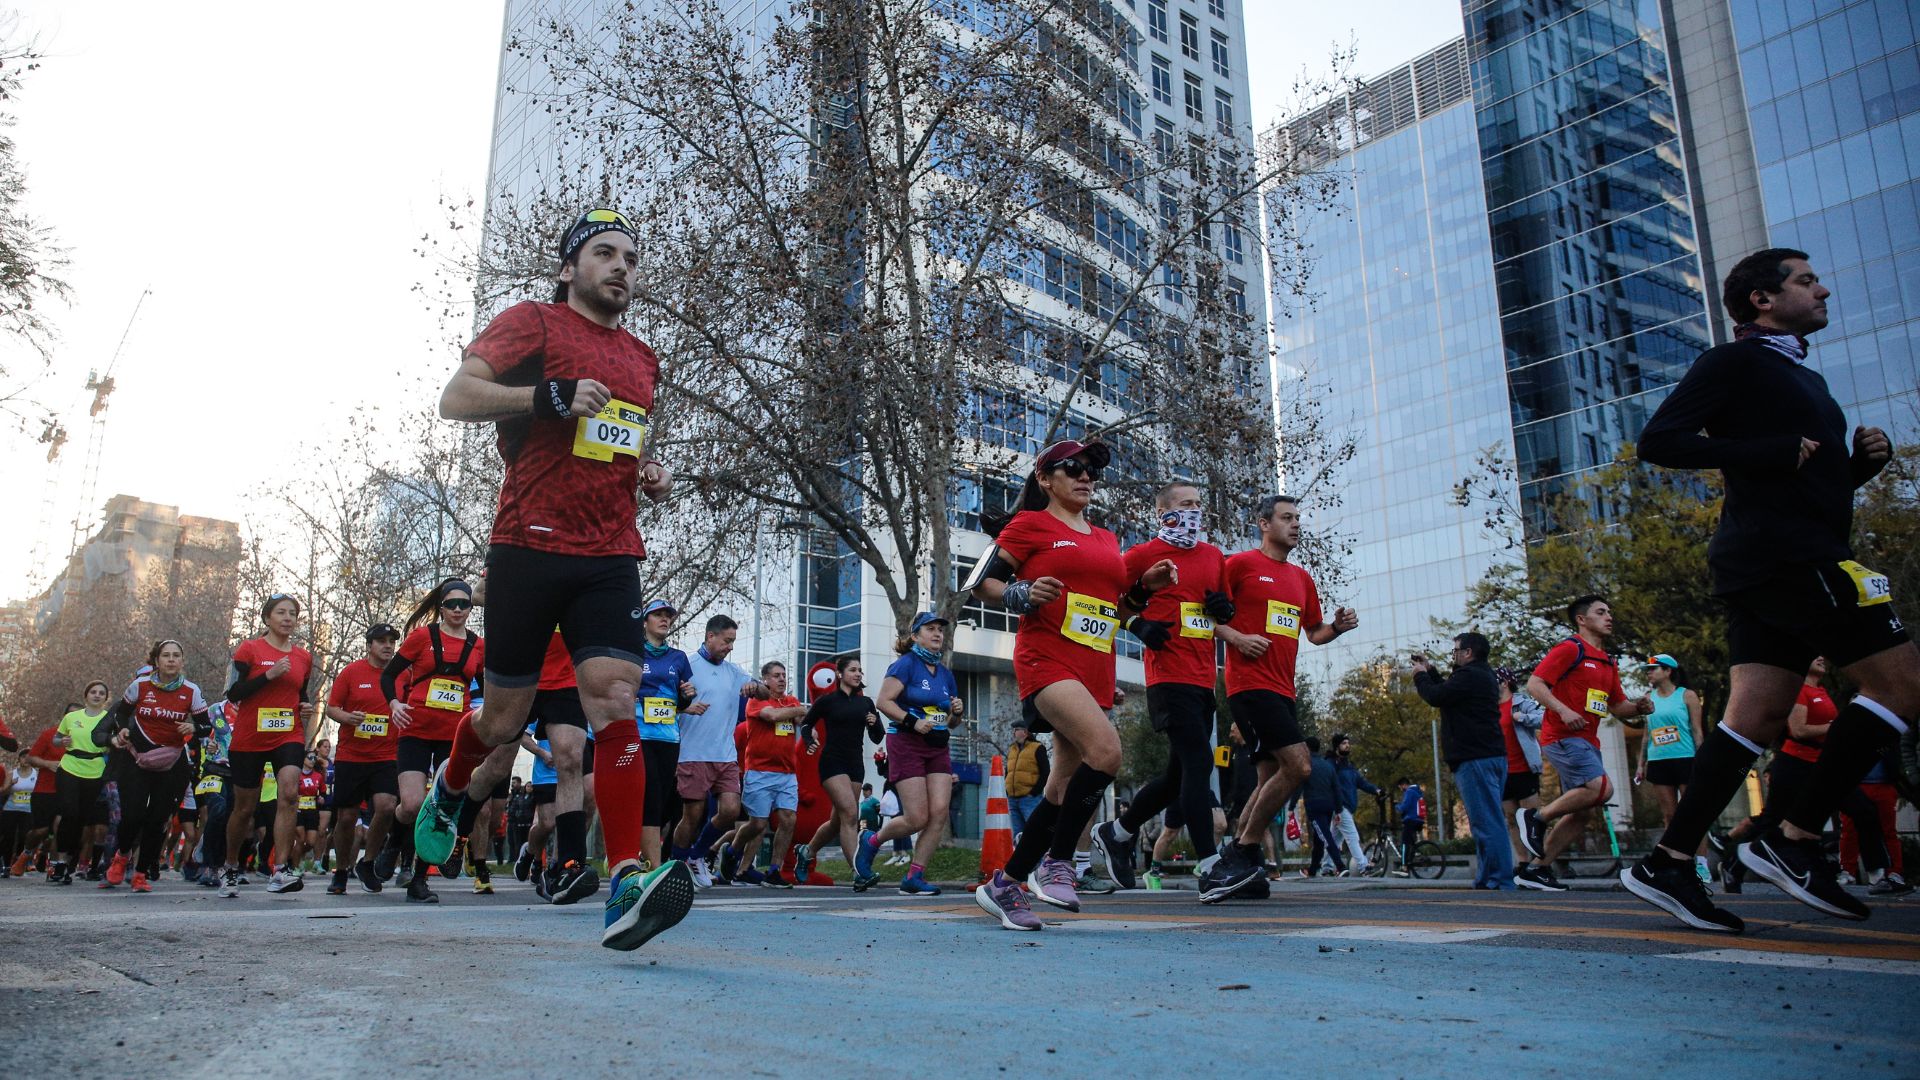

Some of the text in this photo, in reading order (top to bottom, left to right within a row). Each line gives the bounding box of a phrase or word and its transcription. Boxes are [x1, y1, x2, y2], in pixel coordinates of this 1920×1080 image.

[625, 411, 640, 423] 21K
[597, 423, 631, 447] 092
[1053, 540, 1079, 549] HOKA
[1104, 607, 1116, 617] 21K
[1080, 617, 1107, 636] 309
[1191, 618, 1209, 629] 410
[1277, 615, 1293, 628] 812
[436, 690, 456, 702] 746
[654, 708, 669, 717] 564
[268, 719, 286, 728] 385
[933, 714, 945, 723] 413
[361, 723, 382, 732] 1004
[302, 777, 314, 787] R
